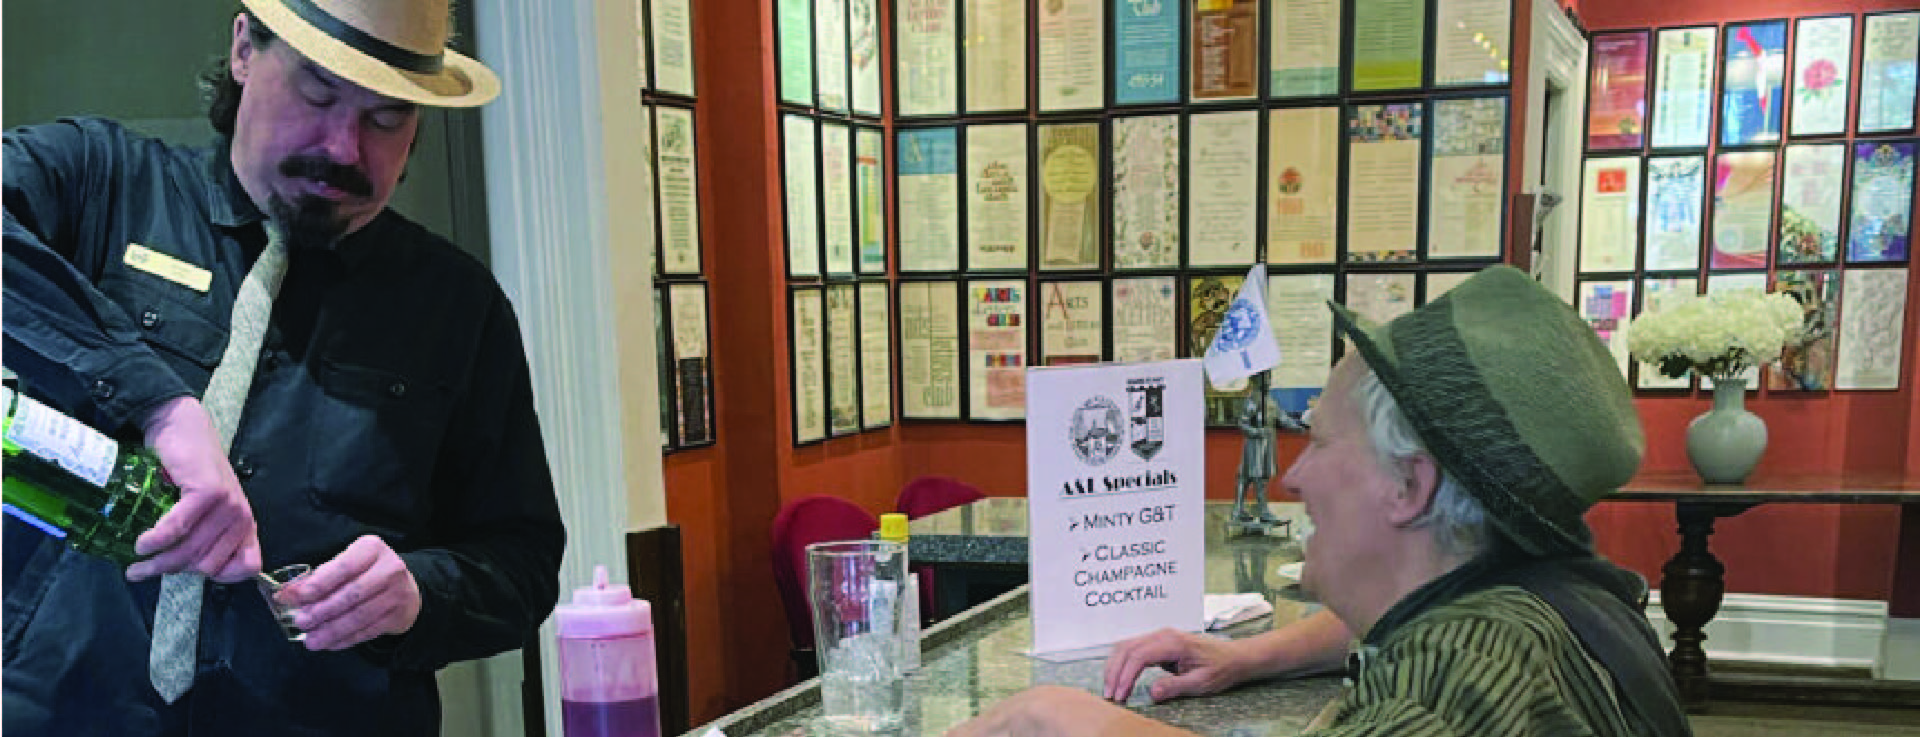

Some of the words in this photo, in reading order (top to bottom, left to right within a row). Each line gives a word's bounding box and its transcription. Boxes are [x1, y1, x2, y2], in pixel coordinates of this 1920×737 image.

[1103, 469, 1177, 491] Specials
[1083, 512, 1135, 531] MINTY
[1139, 503, 1176, 524] G&T
[1094, 539, 1166, 561] CLASSIC
[1074, 561, 1178, 586] CHAMPAGNE
[1085, 585, 1167, 607] COCKTAIL
